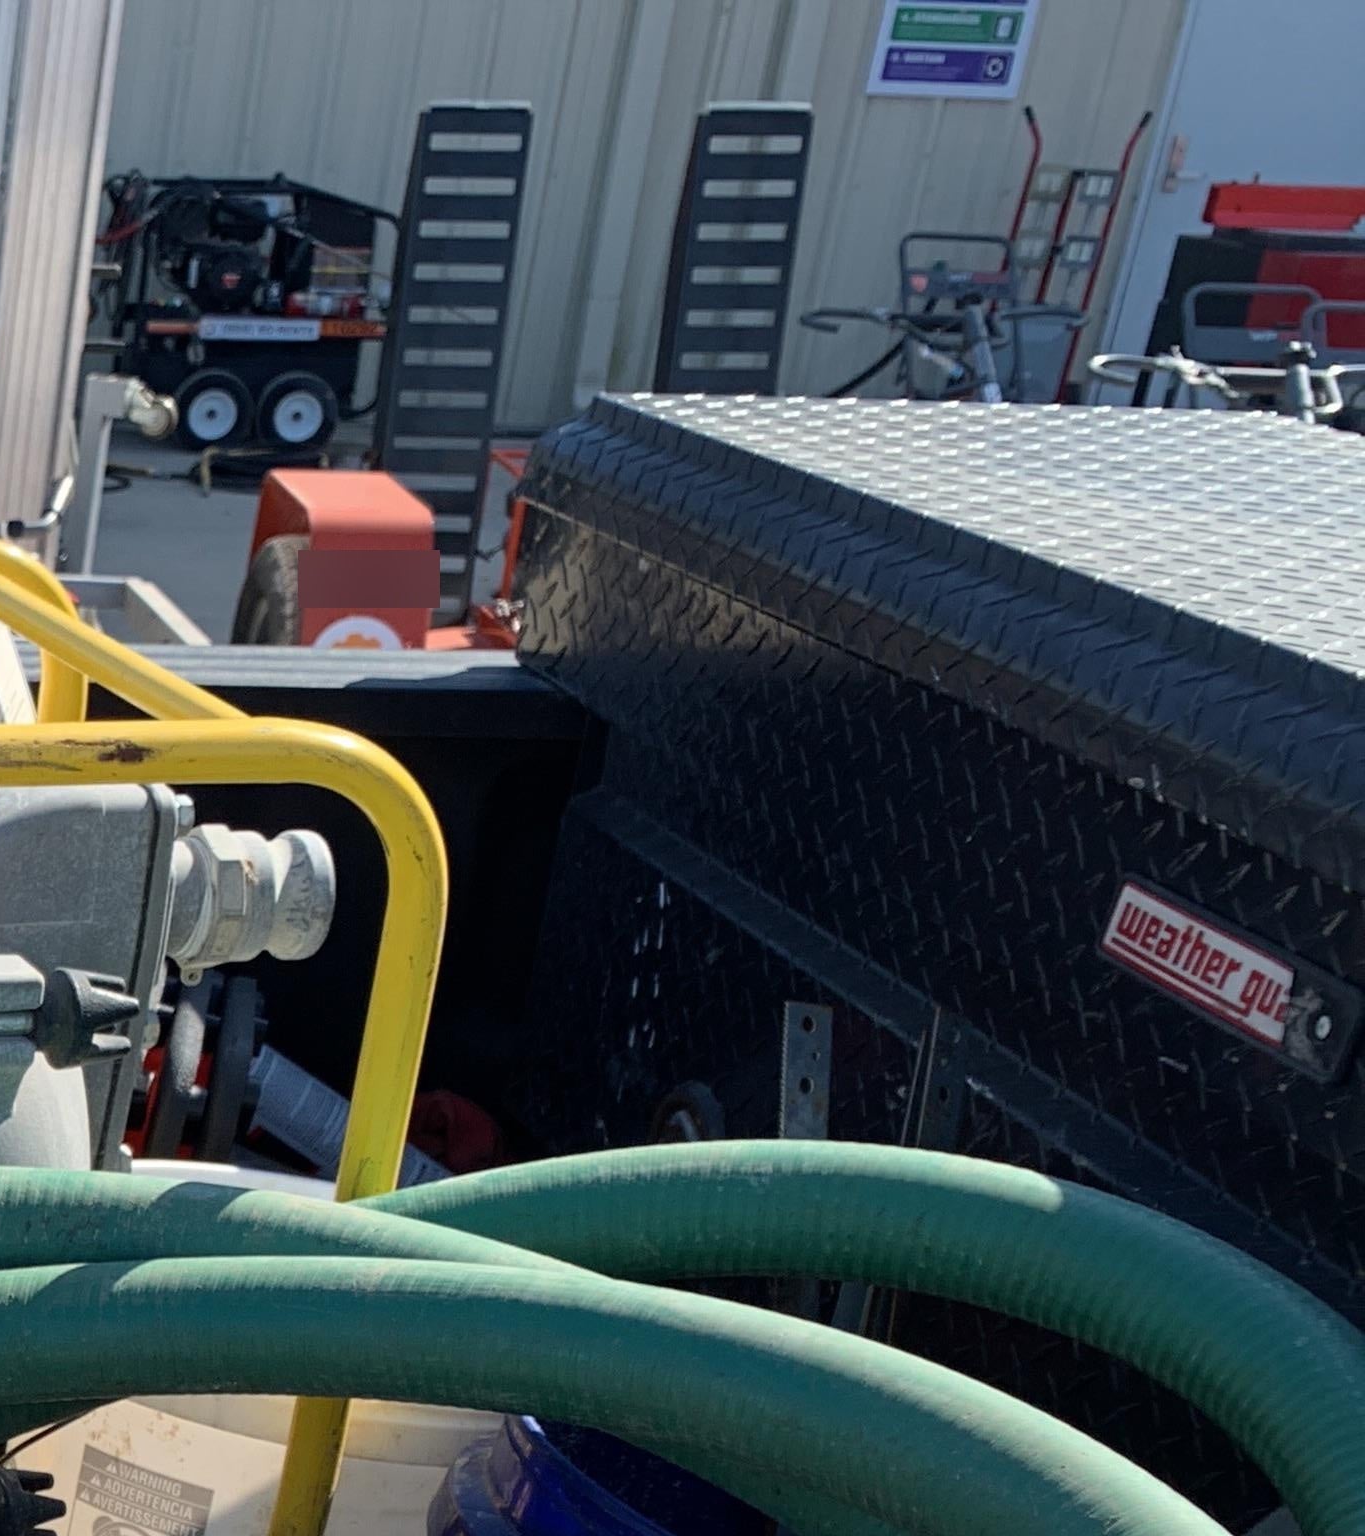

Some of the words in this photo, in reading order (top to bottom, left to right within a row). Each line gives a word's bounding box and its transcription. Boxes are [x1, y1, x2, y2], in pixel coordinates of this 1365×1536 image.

[1115, 900, 1245, 992] weather
[103, 1478, 194, 1521] ADVERTENCIA
[117, 1462, 183, 1498] WARNING
